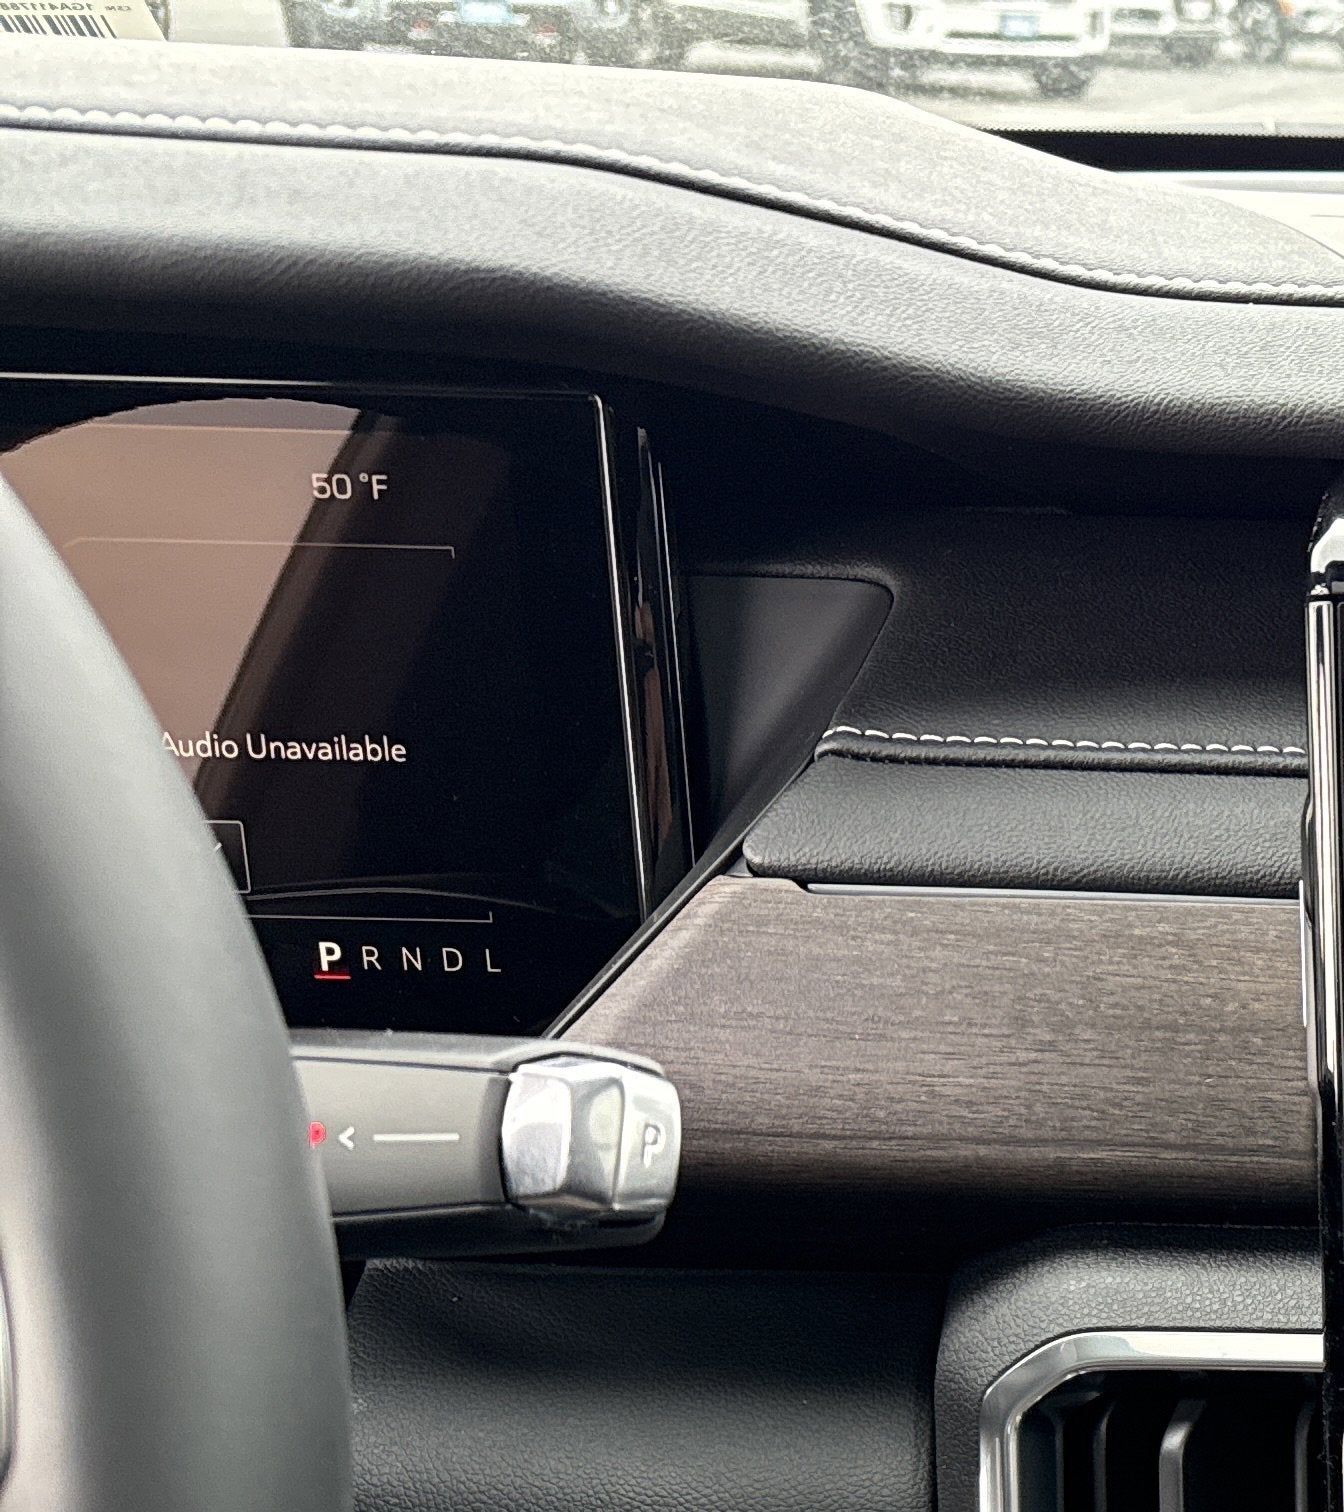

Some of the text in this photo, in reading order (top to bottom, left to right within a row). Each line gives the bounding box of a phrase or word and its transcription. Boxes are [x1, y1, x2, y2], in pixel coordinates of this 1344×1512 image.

[311, 473, 352, 500] 50
[163, 731, 407, 763] Audio Unavailable
[318, 941, 502, 973] P R N D L
